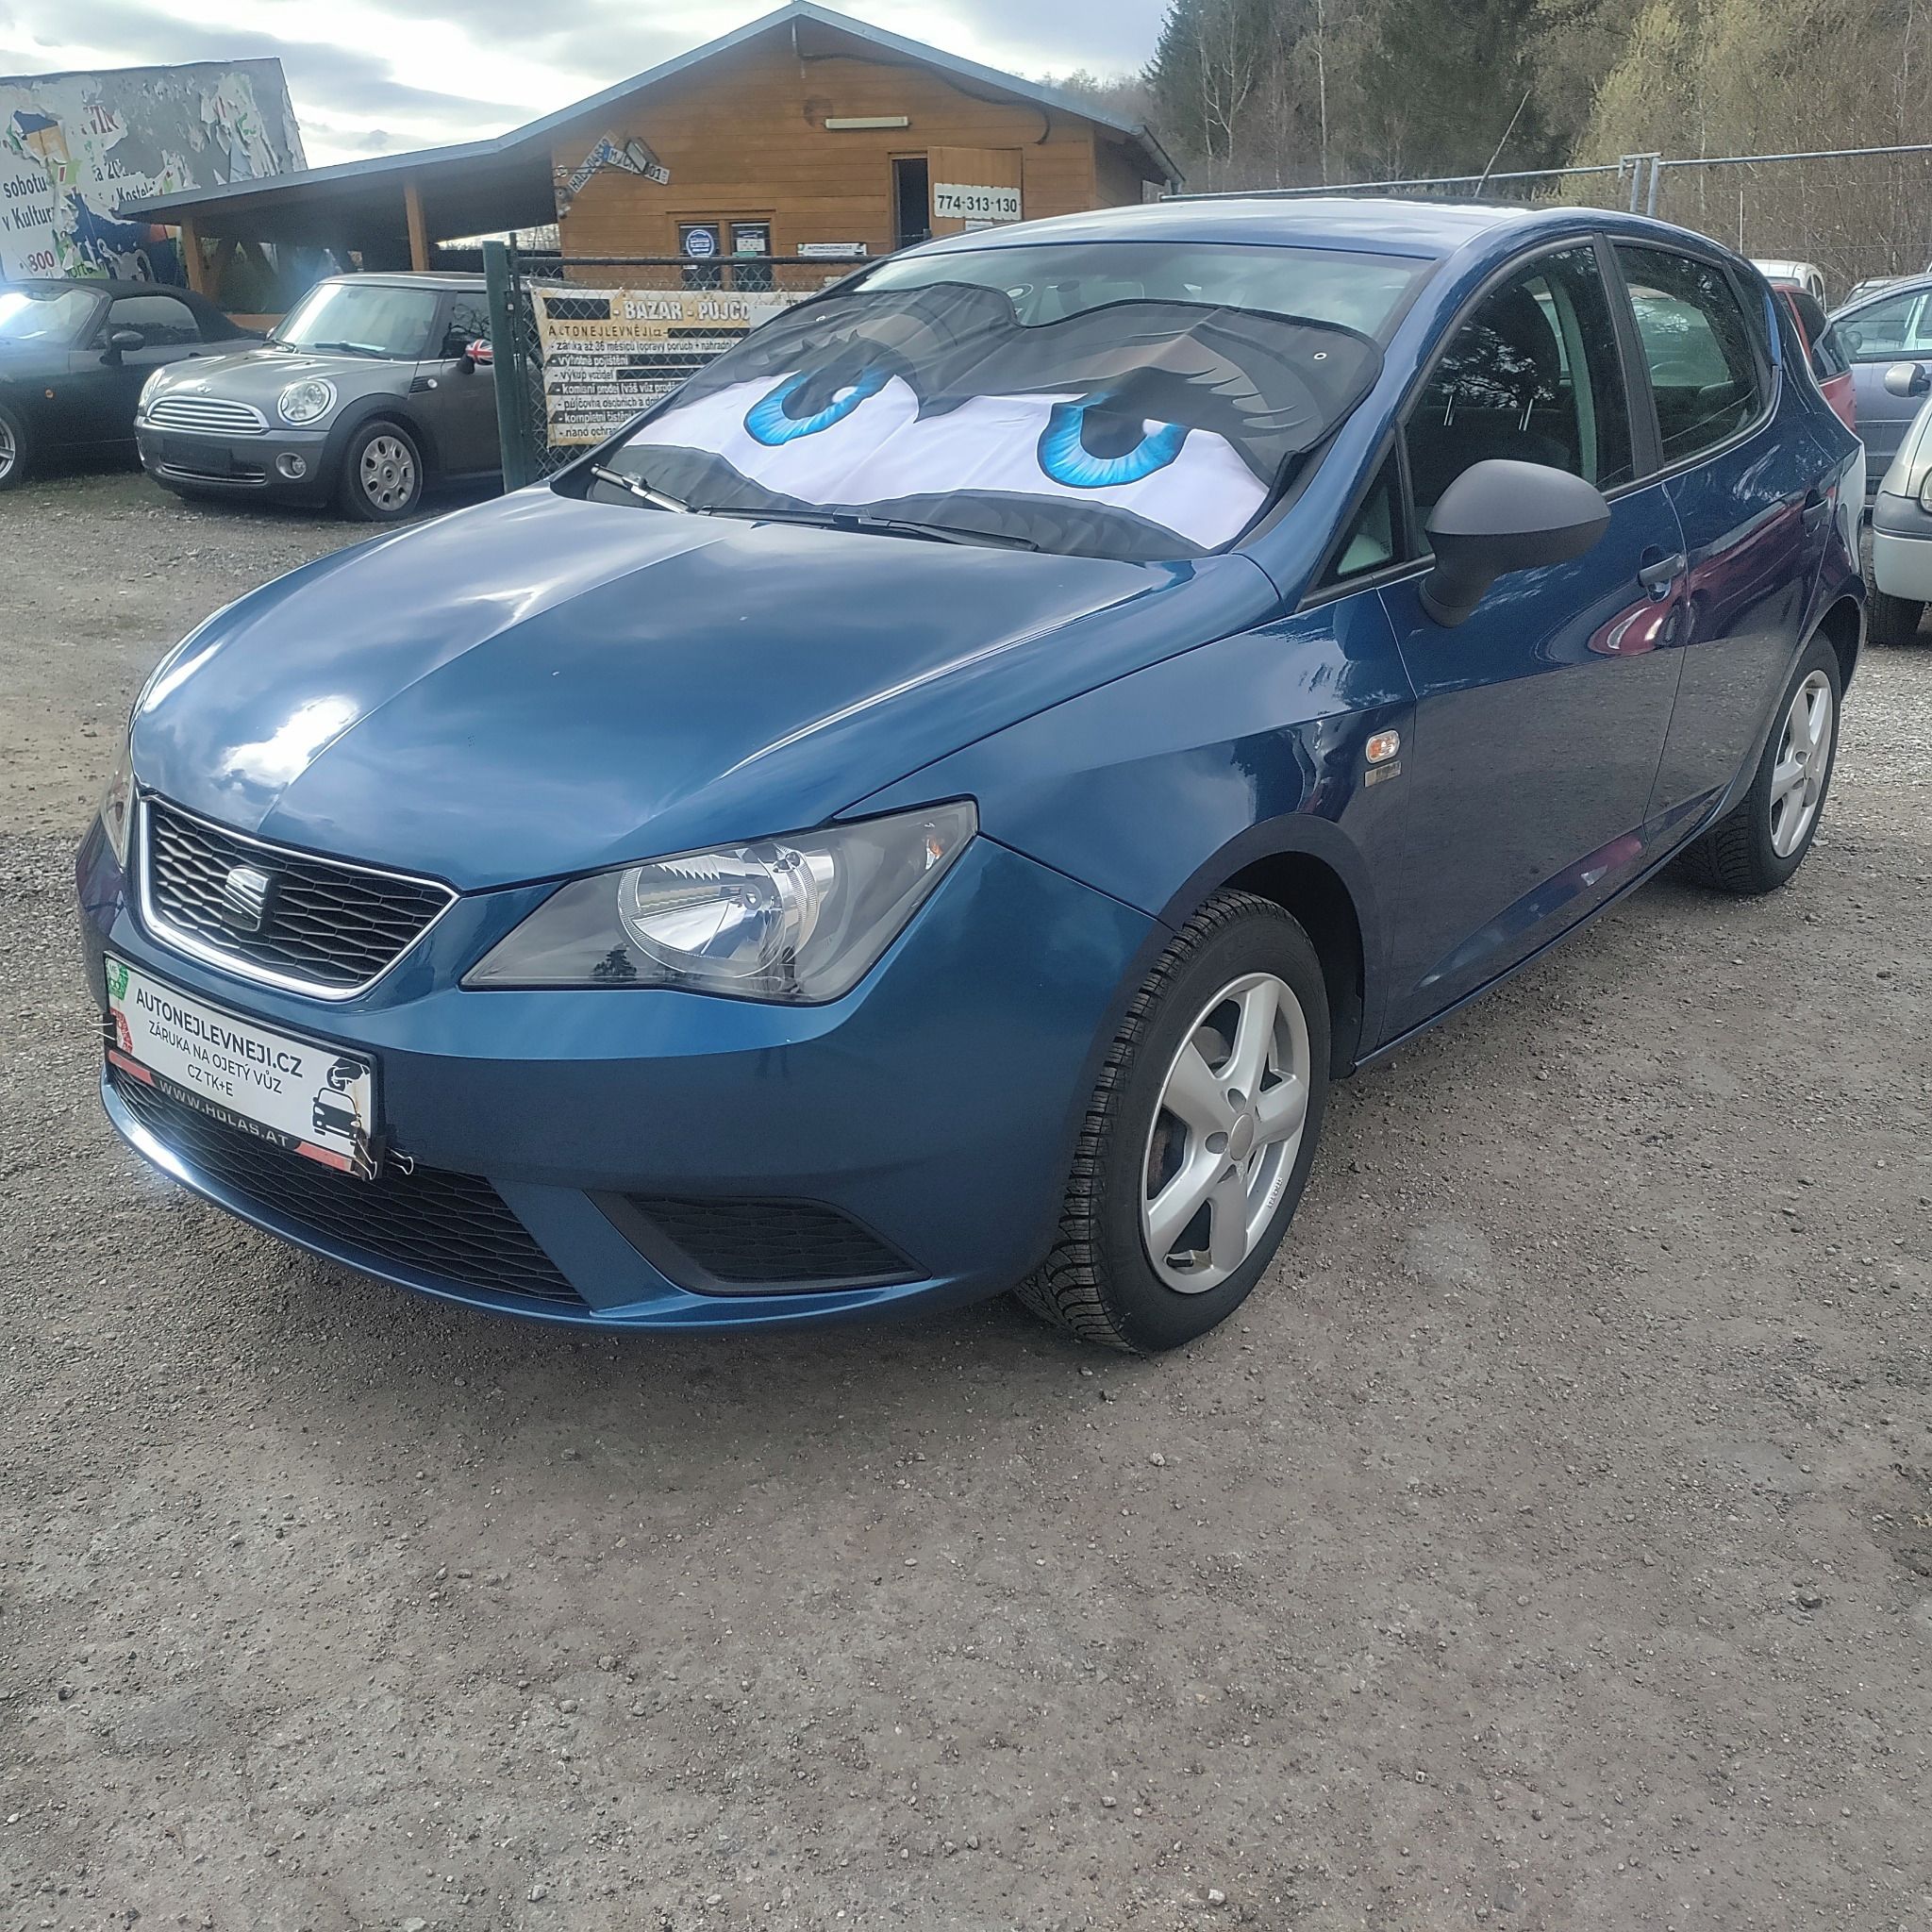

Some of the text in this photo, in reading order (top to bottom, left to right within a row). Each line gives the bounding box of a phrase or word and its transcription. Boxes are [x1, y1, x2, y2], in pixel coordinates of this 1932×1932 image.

[4, 174, 48, 198] sobotu
[937, 194, 1017, 213] 774-313-130
[2, 214, 10, 232] v
[624, 301, 683, 320] BAZAR
[566, 427, 589, 438] nano
[136, 988, 303, 1078] AUTONEJLEVNEJI.CZ
[148, 1019, 192, 1056] ZÁRUKA
[192, 1043, 209, 1064] NA
[211, 1053, 250, 1081] OJETÝ
[253, 1069, 282, 1094] VŮZ
[187, 1063, 234, 1097] CZ TK+E
[158, 1078, 289, 1147] WWW.HOLAS.AT
